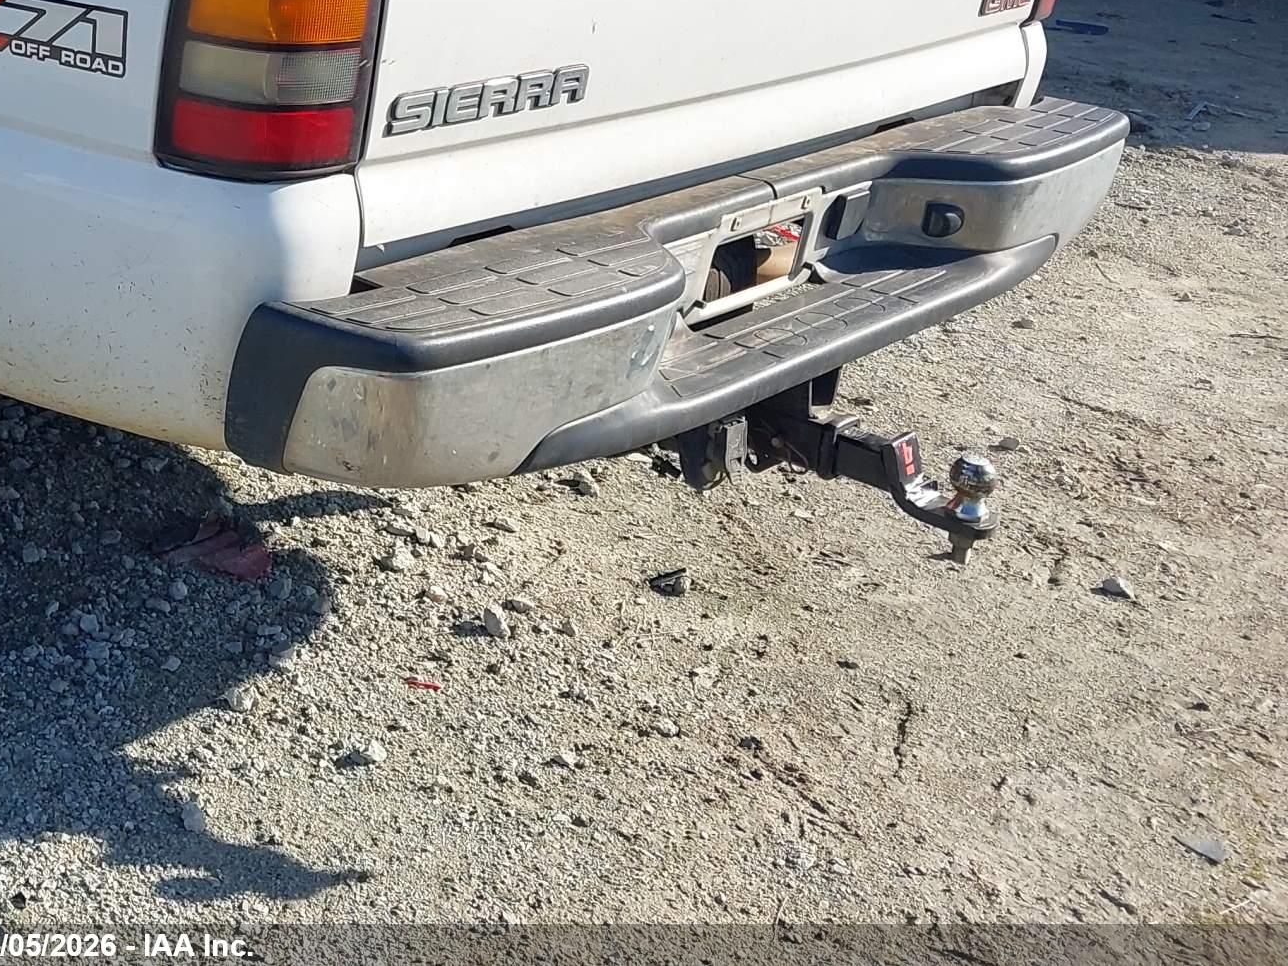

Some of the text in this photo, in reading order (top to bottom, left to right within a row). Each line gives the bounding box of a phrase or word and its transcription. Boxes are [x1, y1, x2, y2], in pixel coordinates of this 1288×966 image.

[11, 38, 124, 76] OFF ROAD
[382, 64, 590, 138] SIERRA
